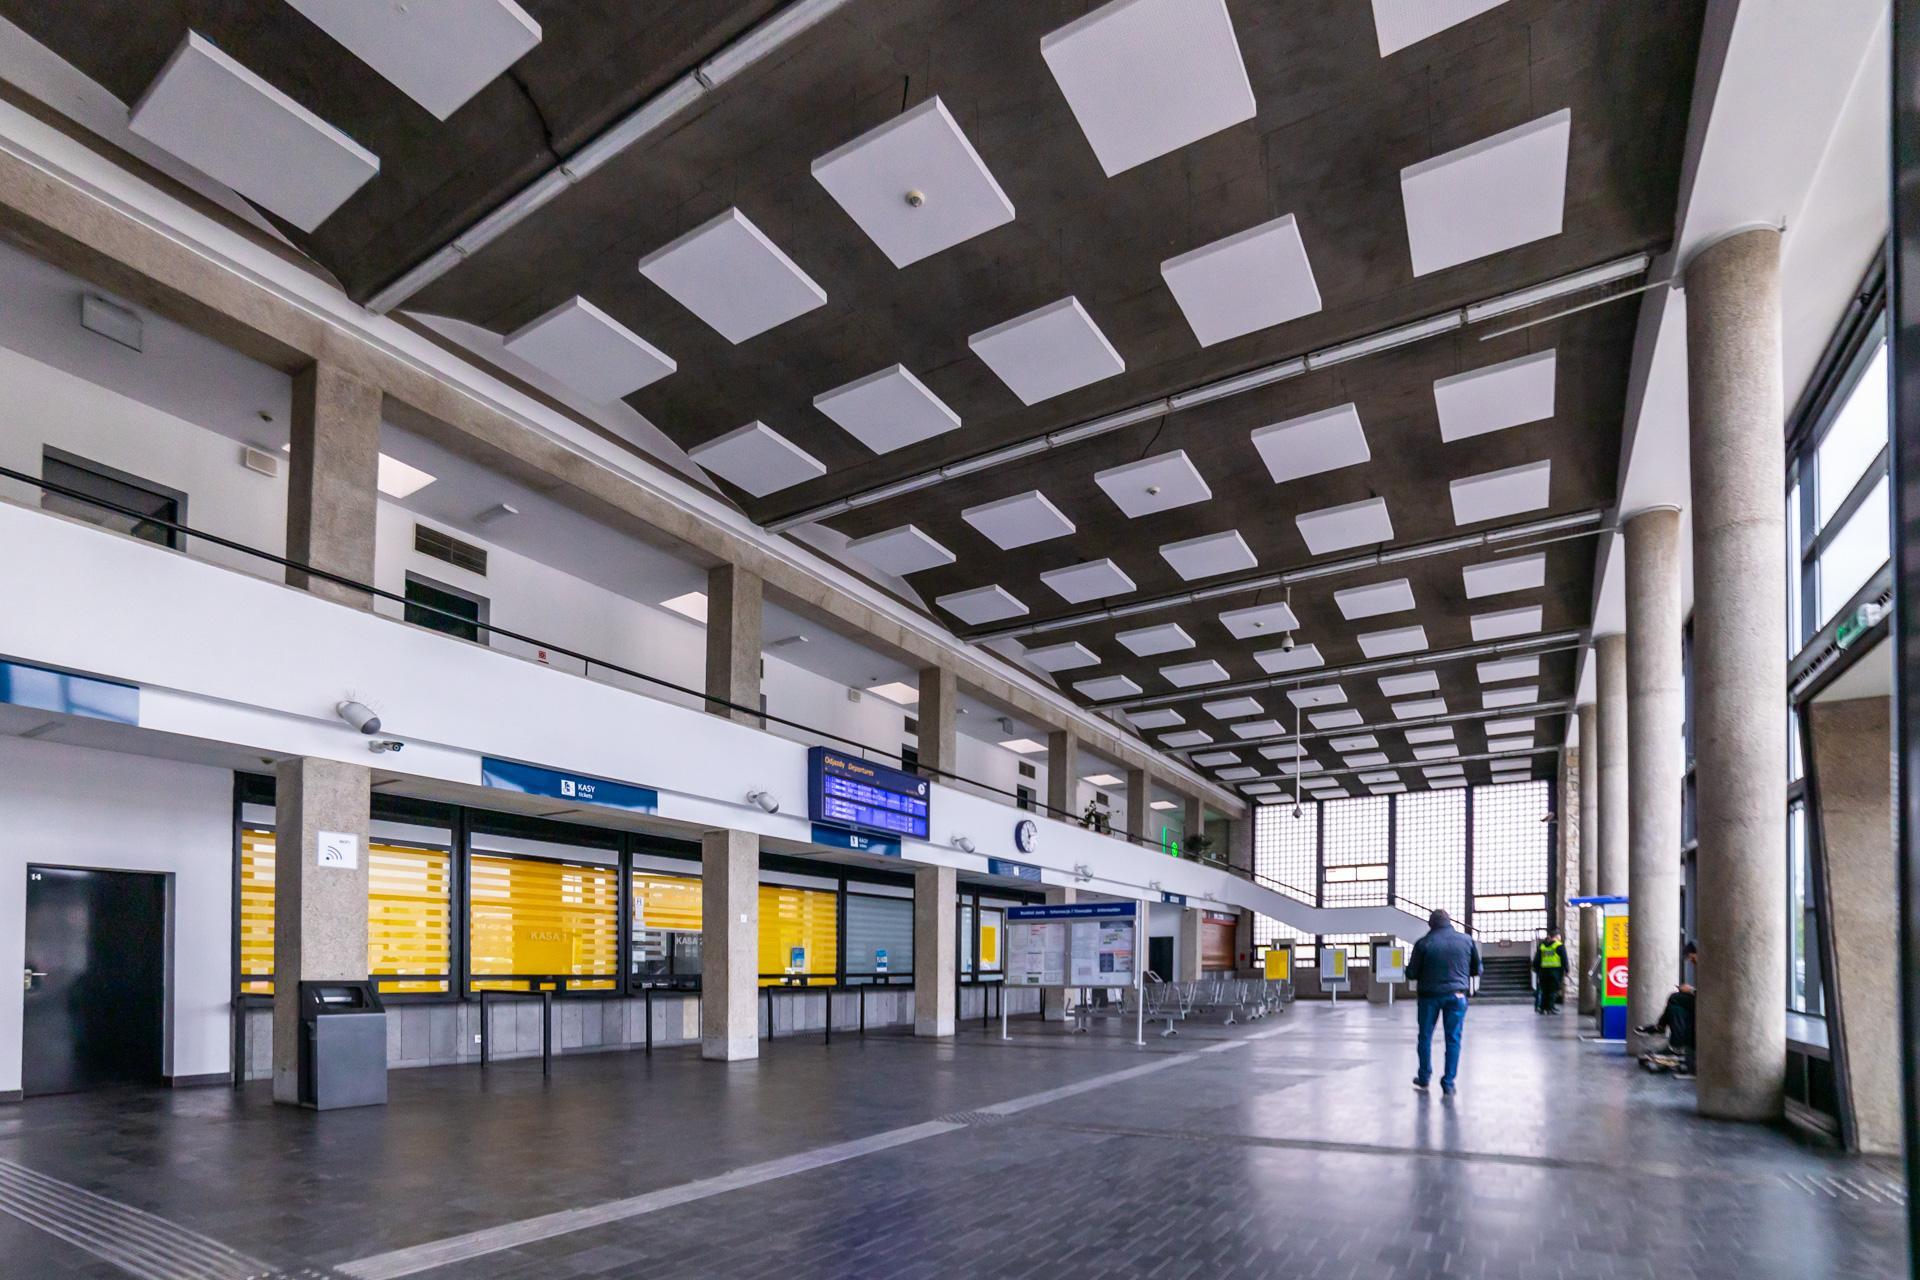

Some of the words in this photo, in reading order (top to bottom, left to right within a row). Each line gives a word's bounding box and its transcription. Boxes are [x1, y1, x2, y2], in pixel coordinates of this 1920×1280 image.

[824, 756, 845, 769] Odjazdy
[848, 763, 874, 777] Departures
[577, 783, 596, 793] KASY
[578, 791, 593, 799] tickets
[530, 932, 560, 942] KASA
[676, 936, 698, 945] KASA
